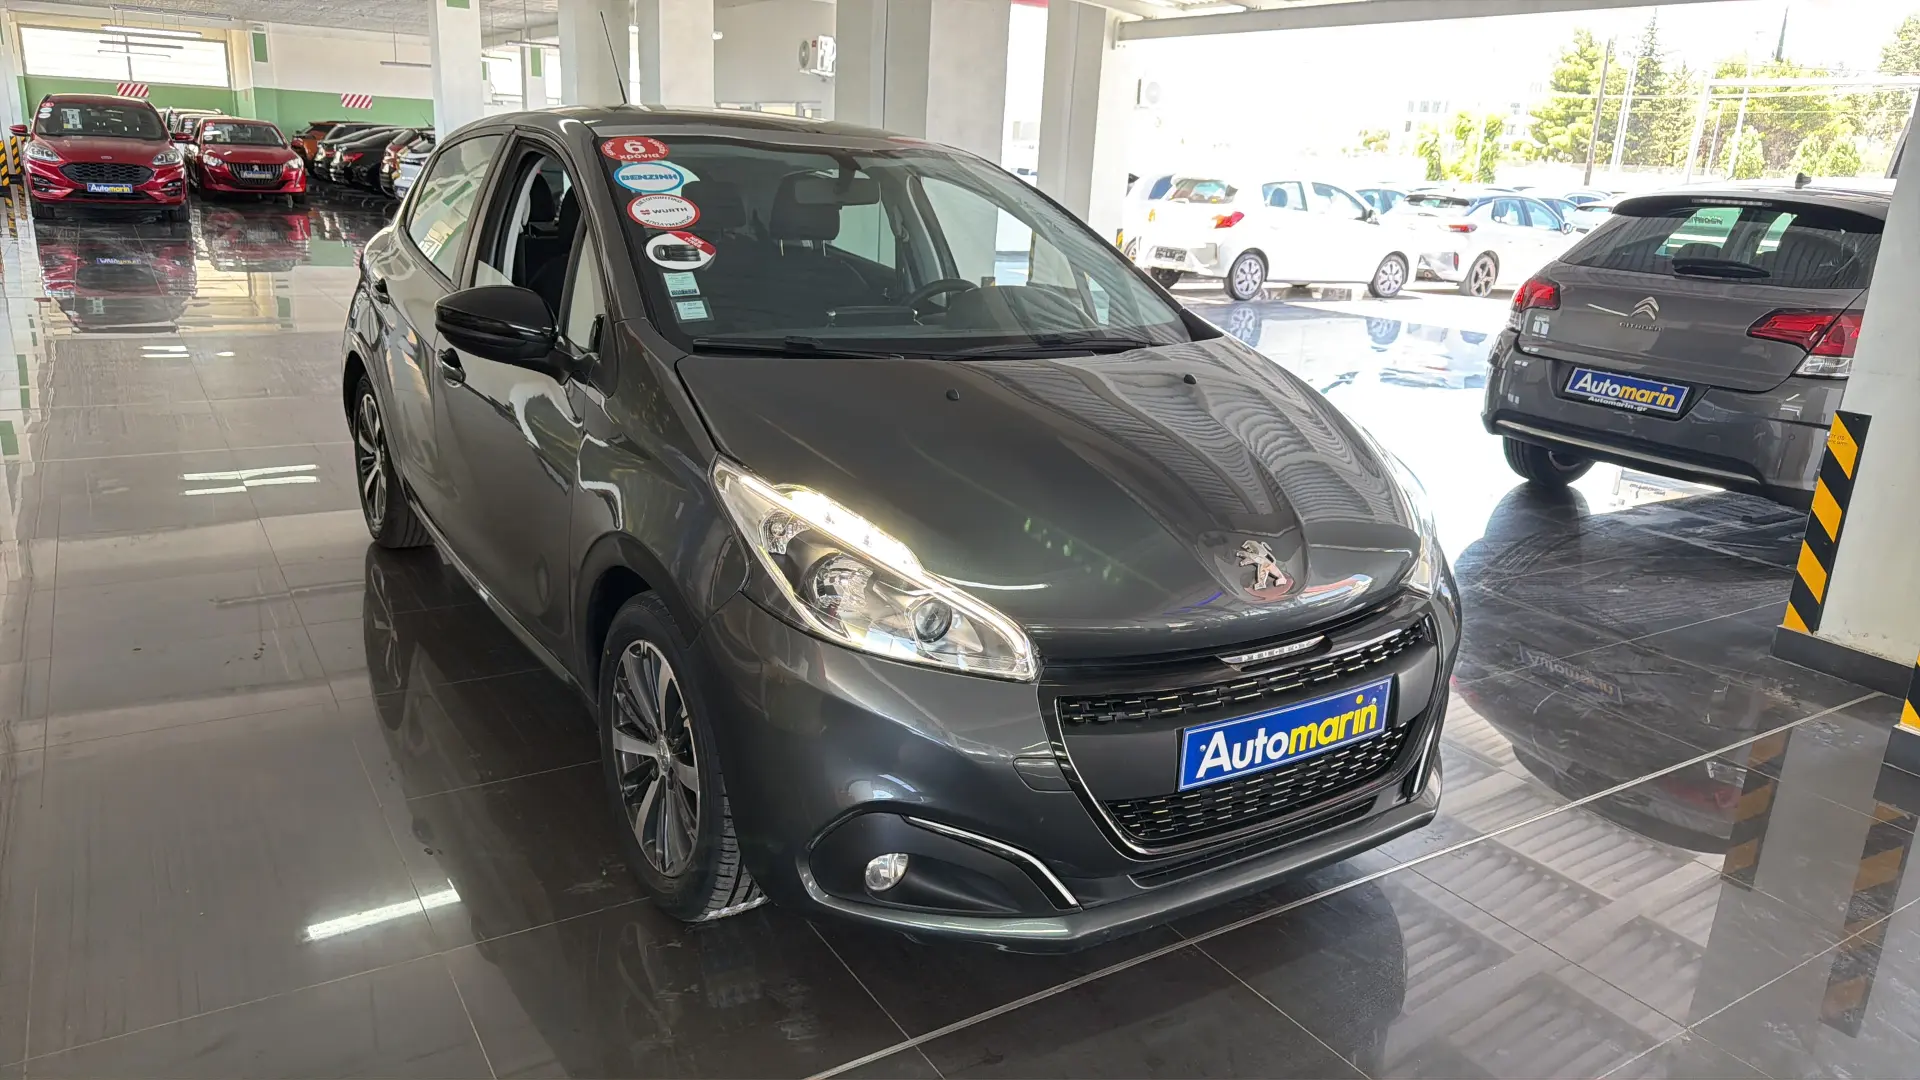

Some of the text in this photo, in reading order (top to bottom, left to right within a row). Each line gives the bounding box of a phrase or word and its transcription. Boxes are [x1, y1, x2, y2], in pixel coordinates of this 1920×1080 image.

[624, 141, 646, 154] 6
[90, 183, 131, 193] Automarin
[1574, 372, 1675, 408] Automarin
[1588, 395, 1648, 412] Automarin.gr
[1195, 694, 1377, 779] Automarin
